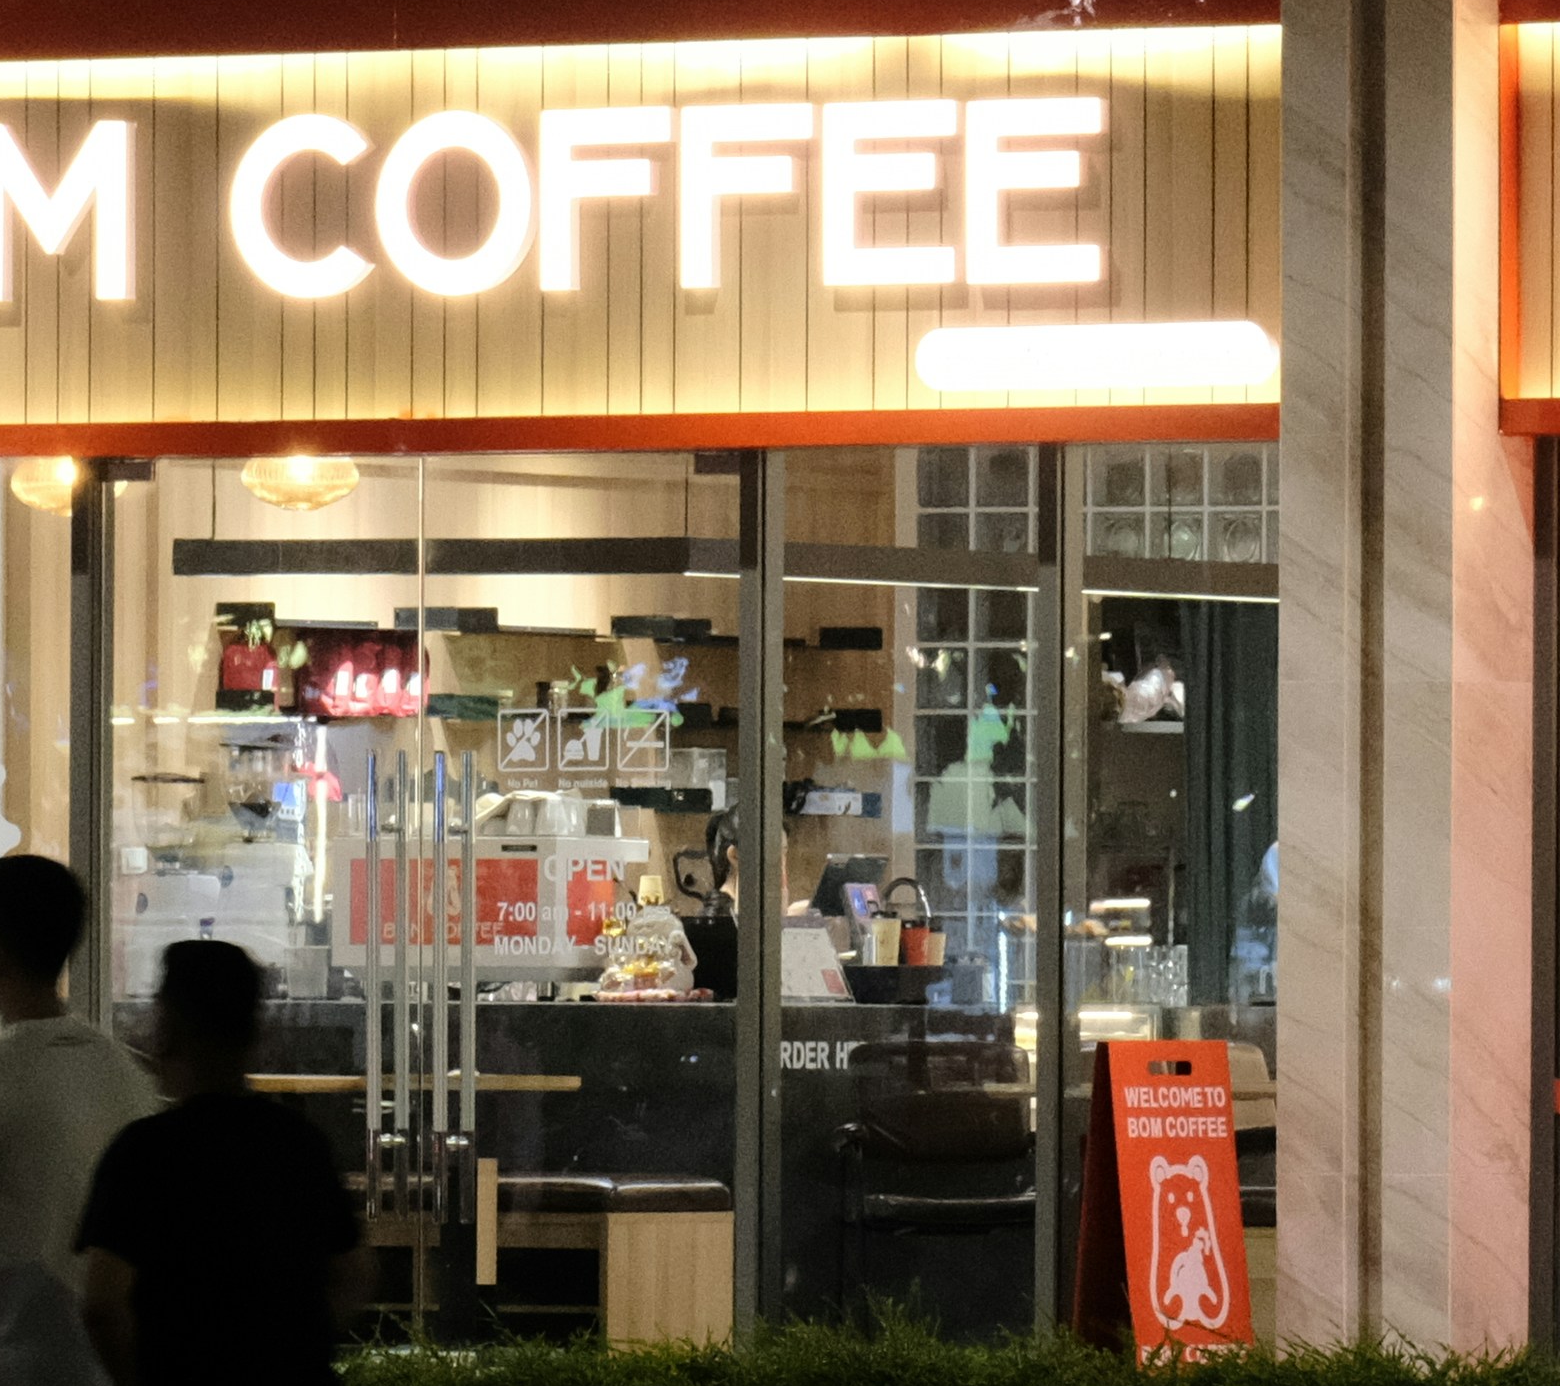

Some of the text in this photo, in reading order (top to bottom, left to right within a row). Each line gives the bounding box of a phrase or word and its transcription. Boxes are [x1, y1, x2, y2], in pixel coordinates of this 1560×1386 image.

[230, 97, 1105, 299] COFFEE
[523, 779, 538, 788] Pet
[558, 779, 569, 788] No
[544, 855, 626, 881] OPEN
[497, 902, 535, 921] 7:00
[588, 902, 636, 921] 11:00
[494, 936, 575, 955] MONDAY
[594, 936, 673, 955] SUNDAY
[1125, 1086, 1226, 1108] WELCOME TO
[1127, 1115, 1227, 1138] BOM COFFEE
